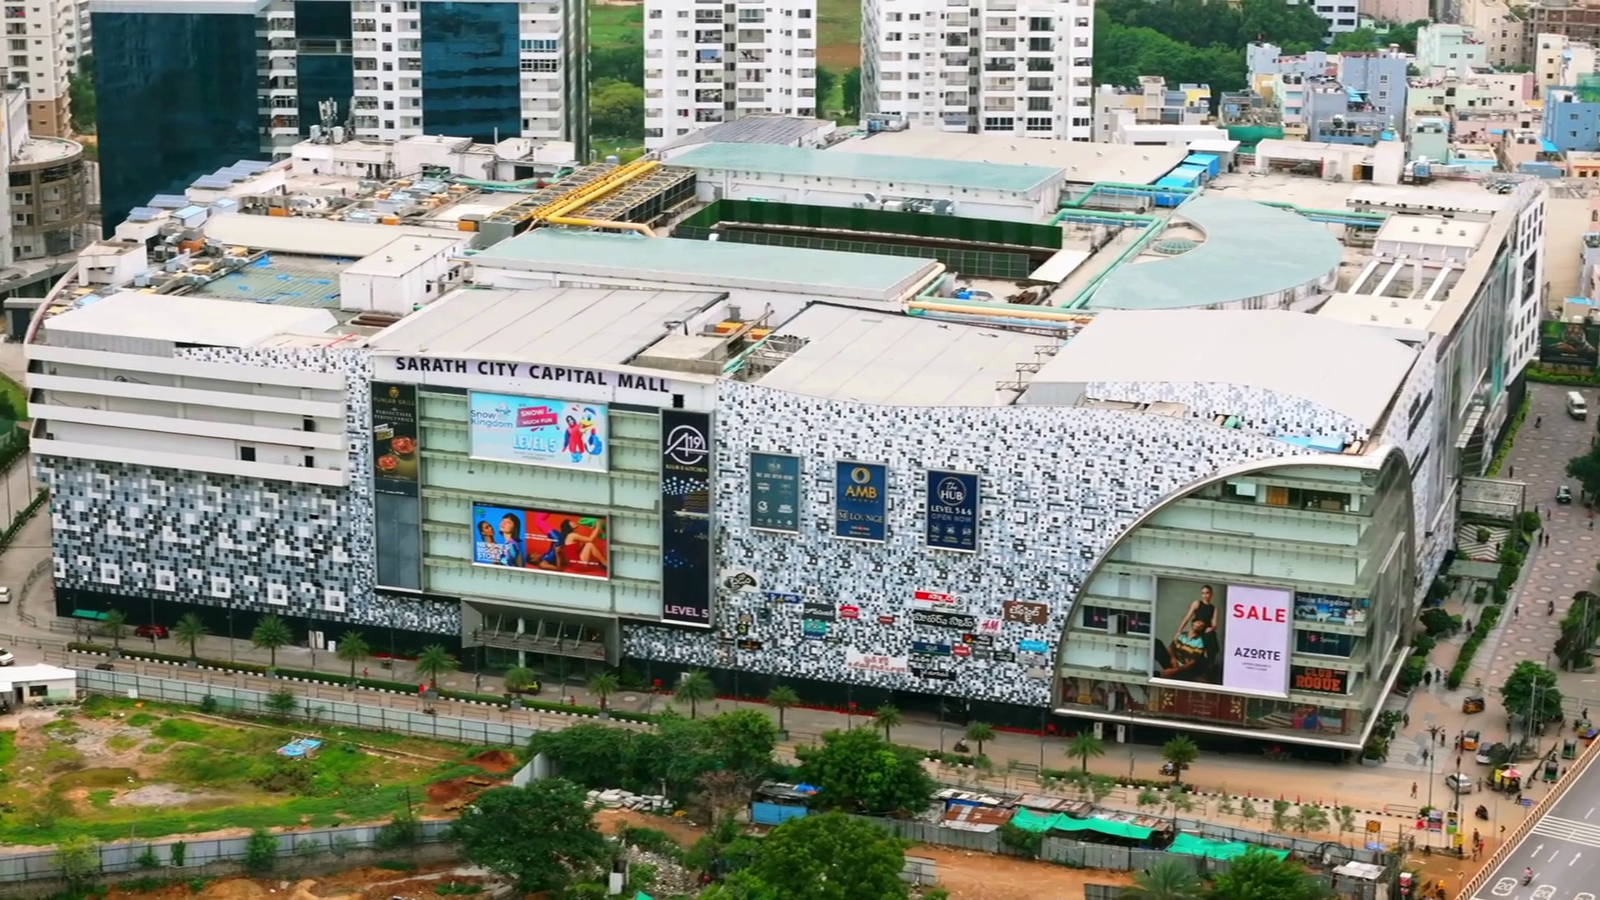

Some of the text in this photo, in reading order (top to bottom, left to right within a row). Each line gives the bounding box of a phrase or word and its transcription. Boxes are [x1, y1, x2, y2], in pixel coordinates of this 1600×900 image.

[396, 356, 669, 393] SARATH CITY CAPITAL MALL
[470, 409, 497, 419] Snow
[520, 409, 545, 417] SNOW
[470, 418, 513, 428] Kingdom
[513, 434, 557, 453] LEVEL 5
[945, 481, 958, 491] The
[845, 485, 877, 499] AMB
[940, 490, 963, 501] HUB
[931, 504, 954, 514] LEVEL
[849, 513, 884, 523] LOUNGE
[931, 513, 952, 521] OPEN
[1317, 597, 1351, 607] Kingdom
[665, 604, 709, 618] LEVEL 5
[1233, 603, 1286, 623] SALE
[981, 619, 999, 631] H&M
[1234, 647, 1281, 661] AZORTE
[1305, 668, 1332, 678] CLUB
[1295, 675, 1341, 692] ROGUE
